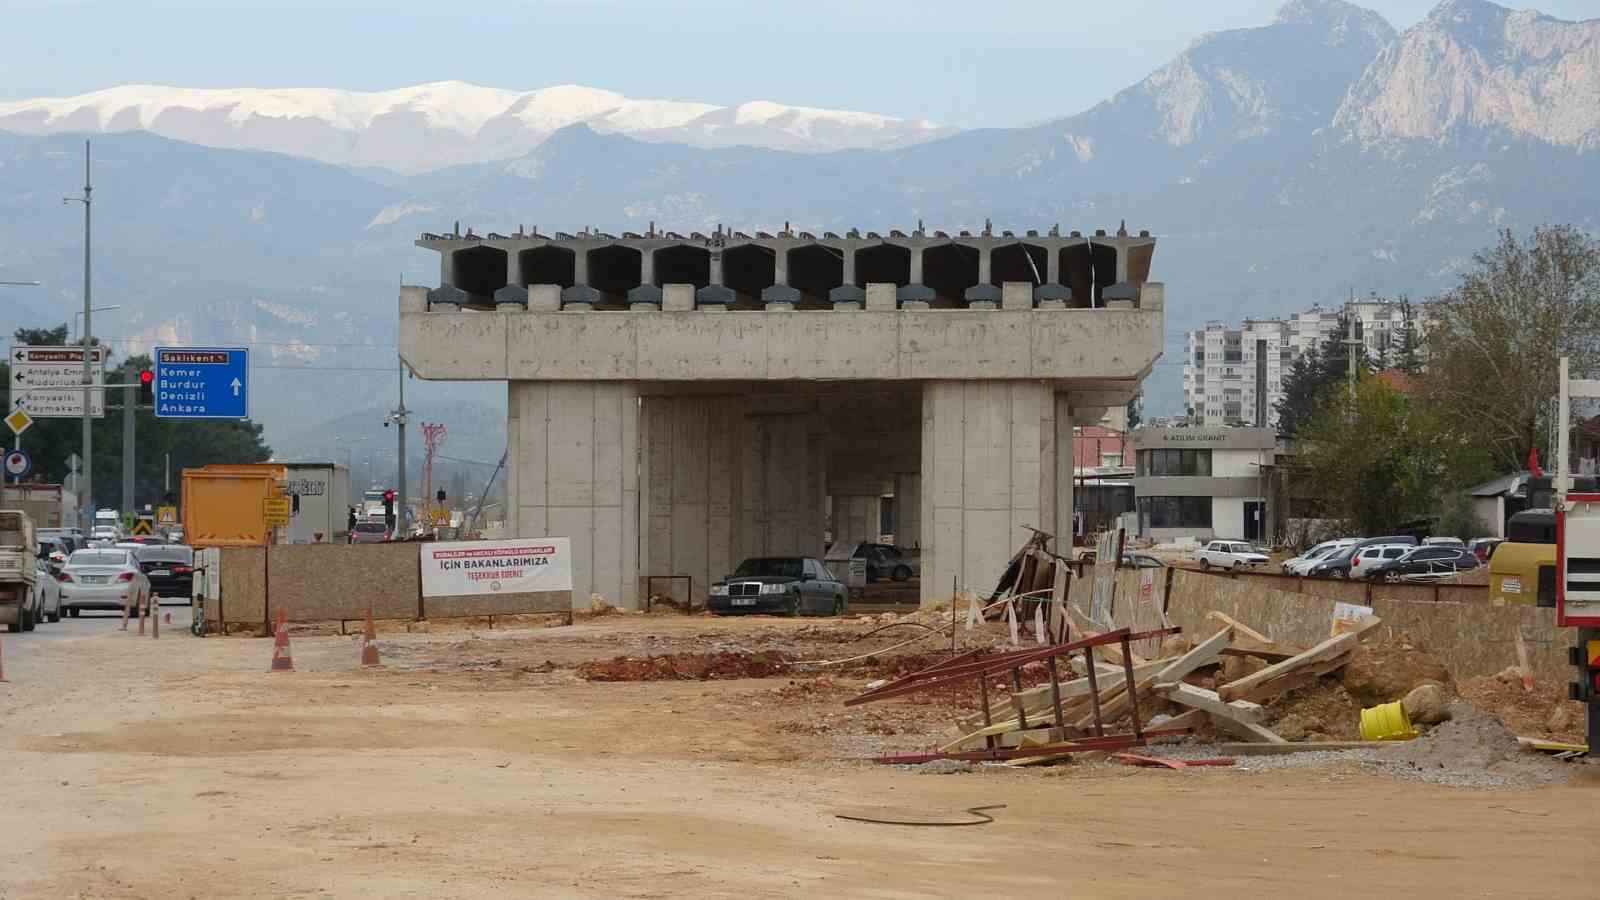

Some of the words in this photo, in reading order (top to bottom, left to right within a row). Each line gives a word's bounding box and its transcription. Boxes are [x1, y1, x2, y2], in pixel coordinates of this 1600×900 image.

[163, 353, 215, 362] Saklıkent
[27, 368, 60, 376] Antalya
[160, 367, 201, 377] Kemer
[160, 380, 205, 389] Burdur
[160, 391, 205, 401] Denizli
[160, 403, 206, 413] Ankara
[440, 560, 461, 570] İÇİN
[464, 557, 549, 569] BAKANLARIMIZA
